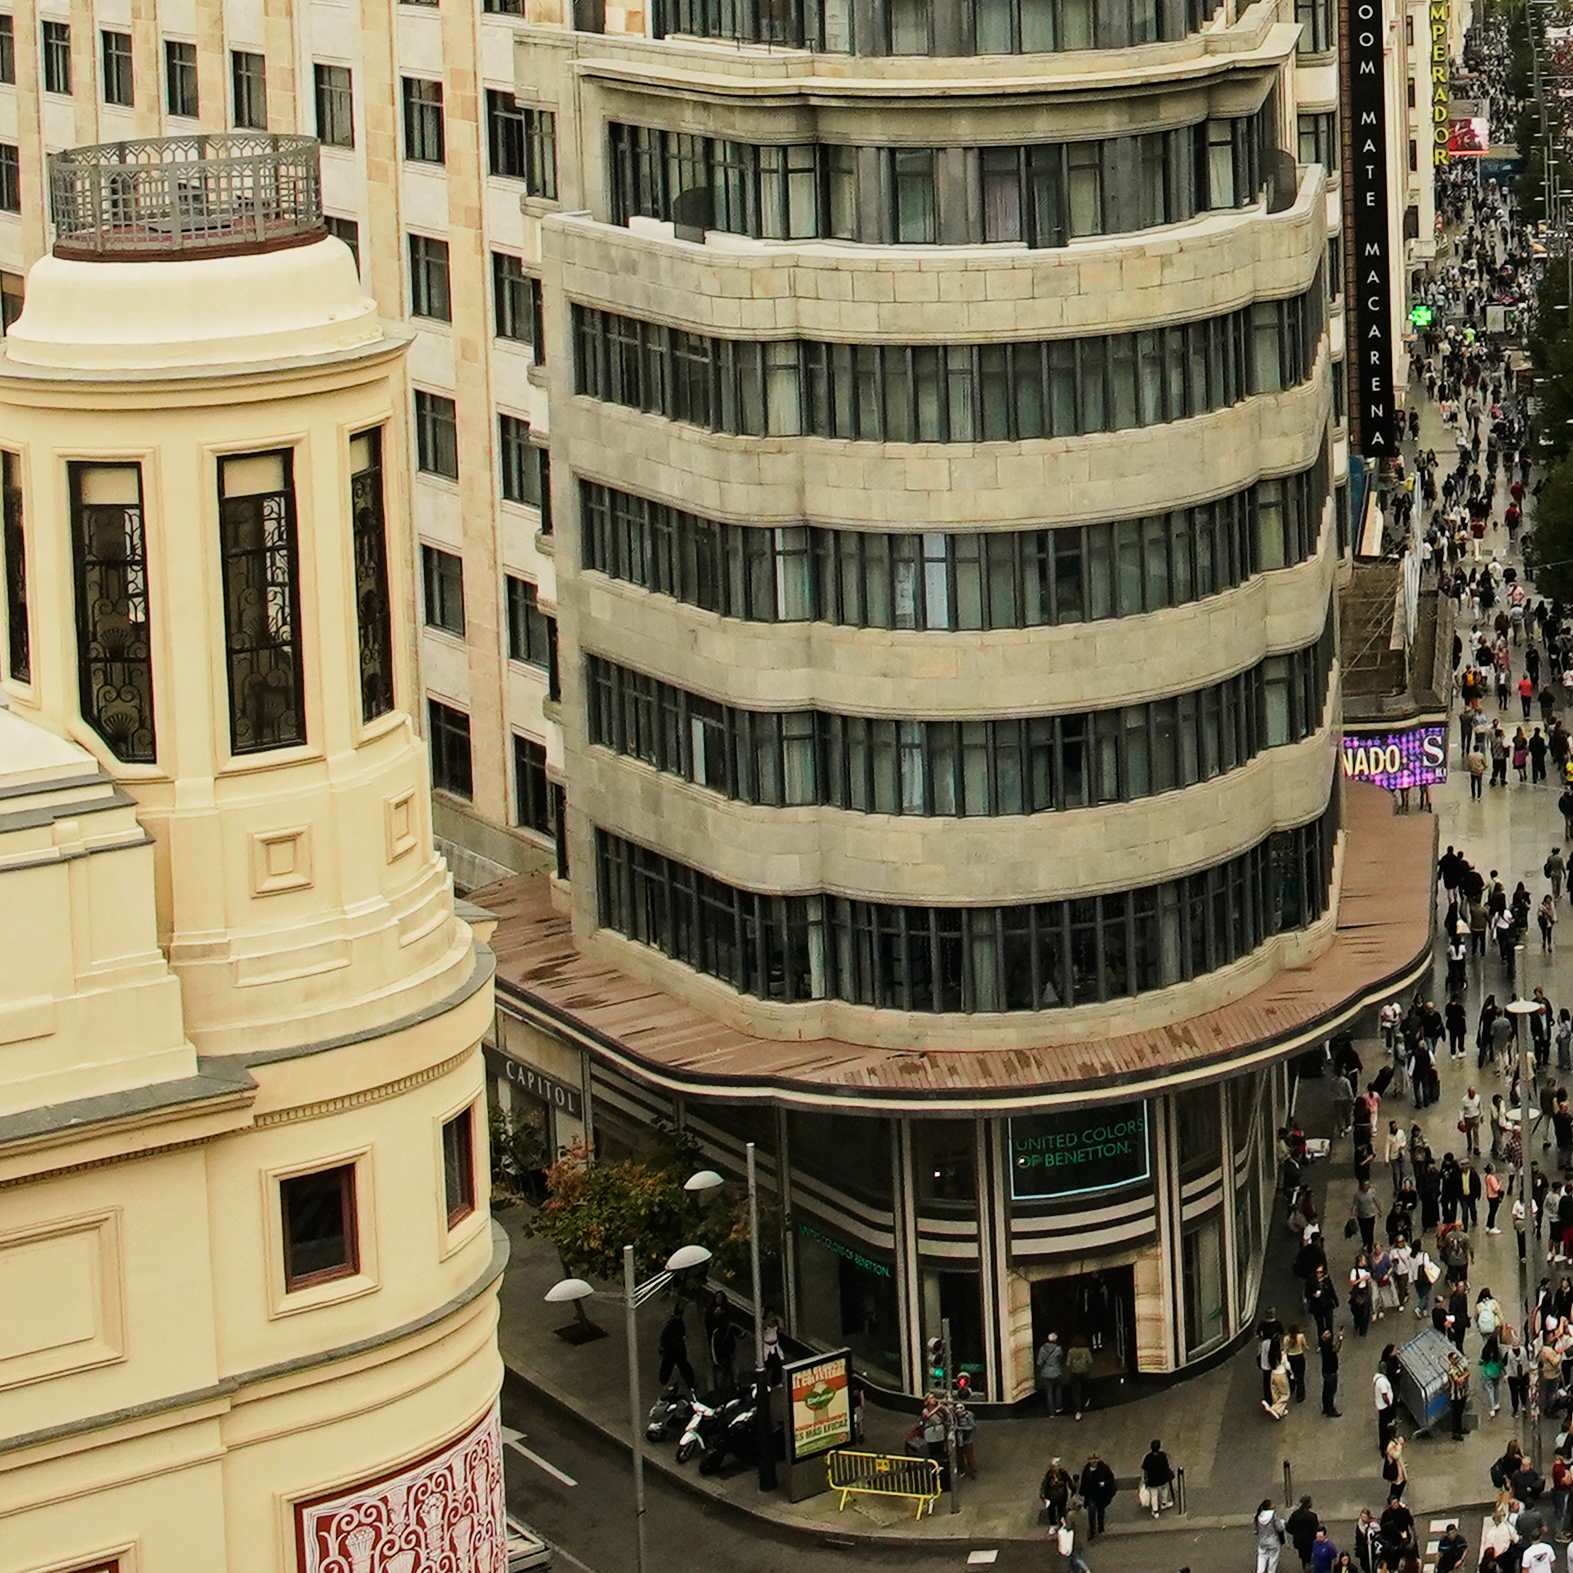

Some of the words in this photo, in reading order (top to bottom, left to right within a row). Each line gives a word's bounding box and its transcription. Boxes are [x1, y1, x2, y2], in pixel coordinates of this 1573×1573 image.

[1361, 111, 1377, 207] MATE
[1364, 242, 1385, 445] MACARENA
[505, 1060, 576, 1114] CAPITOL
[1016, 1132, 1078, 1151] UNITED
[1082, 1118, 1144, 1144] COLORS
[1018, 1154, 1042, 1169] OF
[1045, 1140, 1131, 1168] BENETTON.
